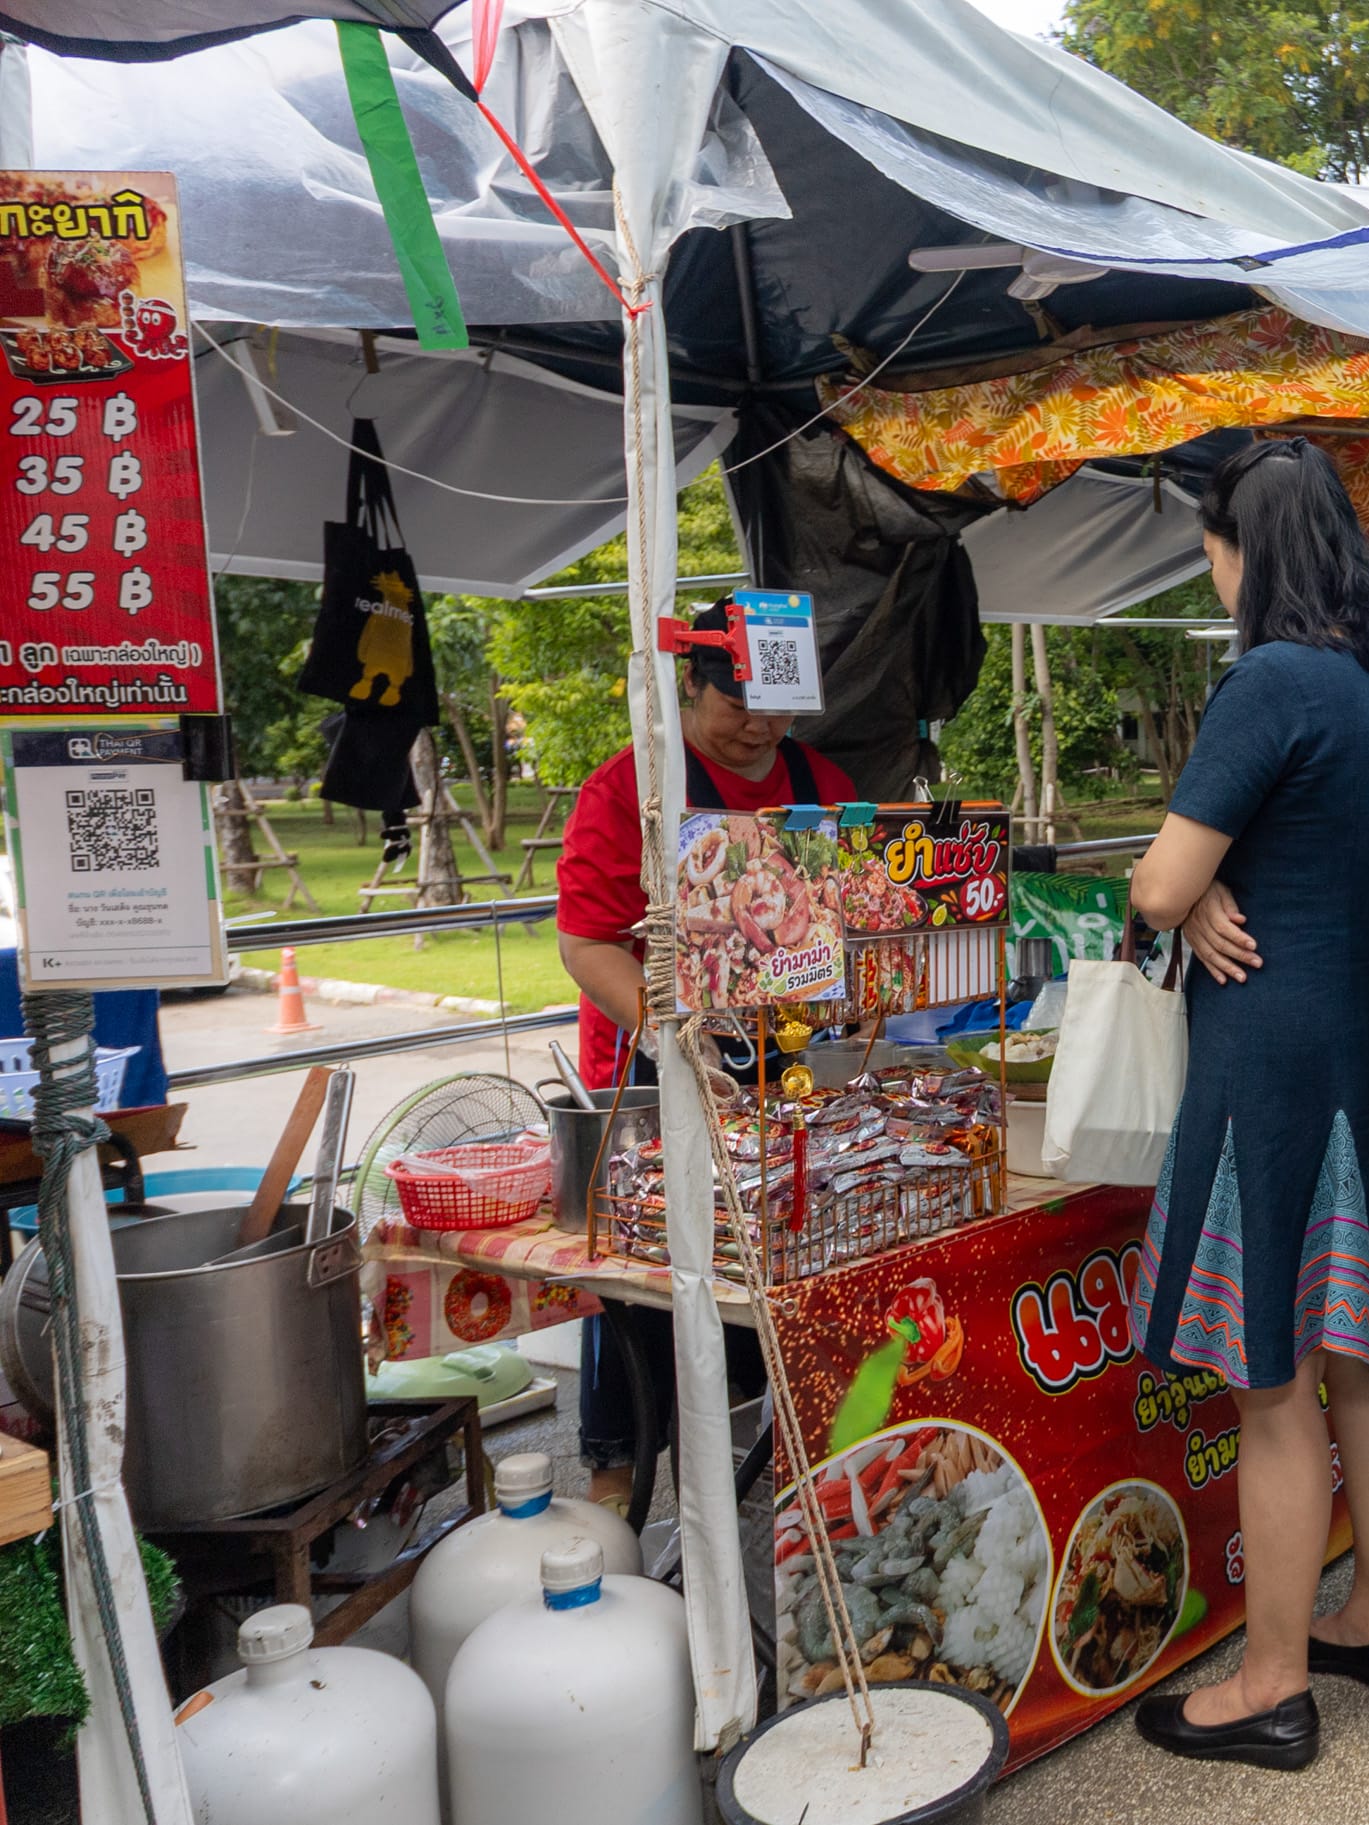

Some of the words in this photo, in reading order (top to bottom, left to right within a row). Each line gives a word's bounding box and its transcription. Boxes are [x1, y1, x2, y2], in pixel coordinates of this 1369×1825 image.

[9, 396, 79, 436] 25
[102, 391, 138, 442] ฿
[15, 454, 84, 495] 35
[108, 450, 143, 500] ฿
[20, 513, 90, 552] 45
[113, 508, 148, 558] ฿
[27, 571, 96, 611] 55
[118, 566, 153, 616] ฿
[22, 644, 57, 670] ลูก
[771, 940, 831, 978] ยำมาม่า
[788, 965, 833, 990] รวมมิตร
